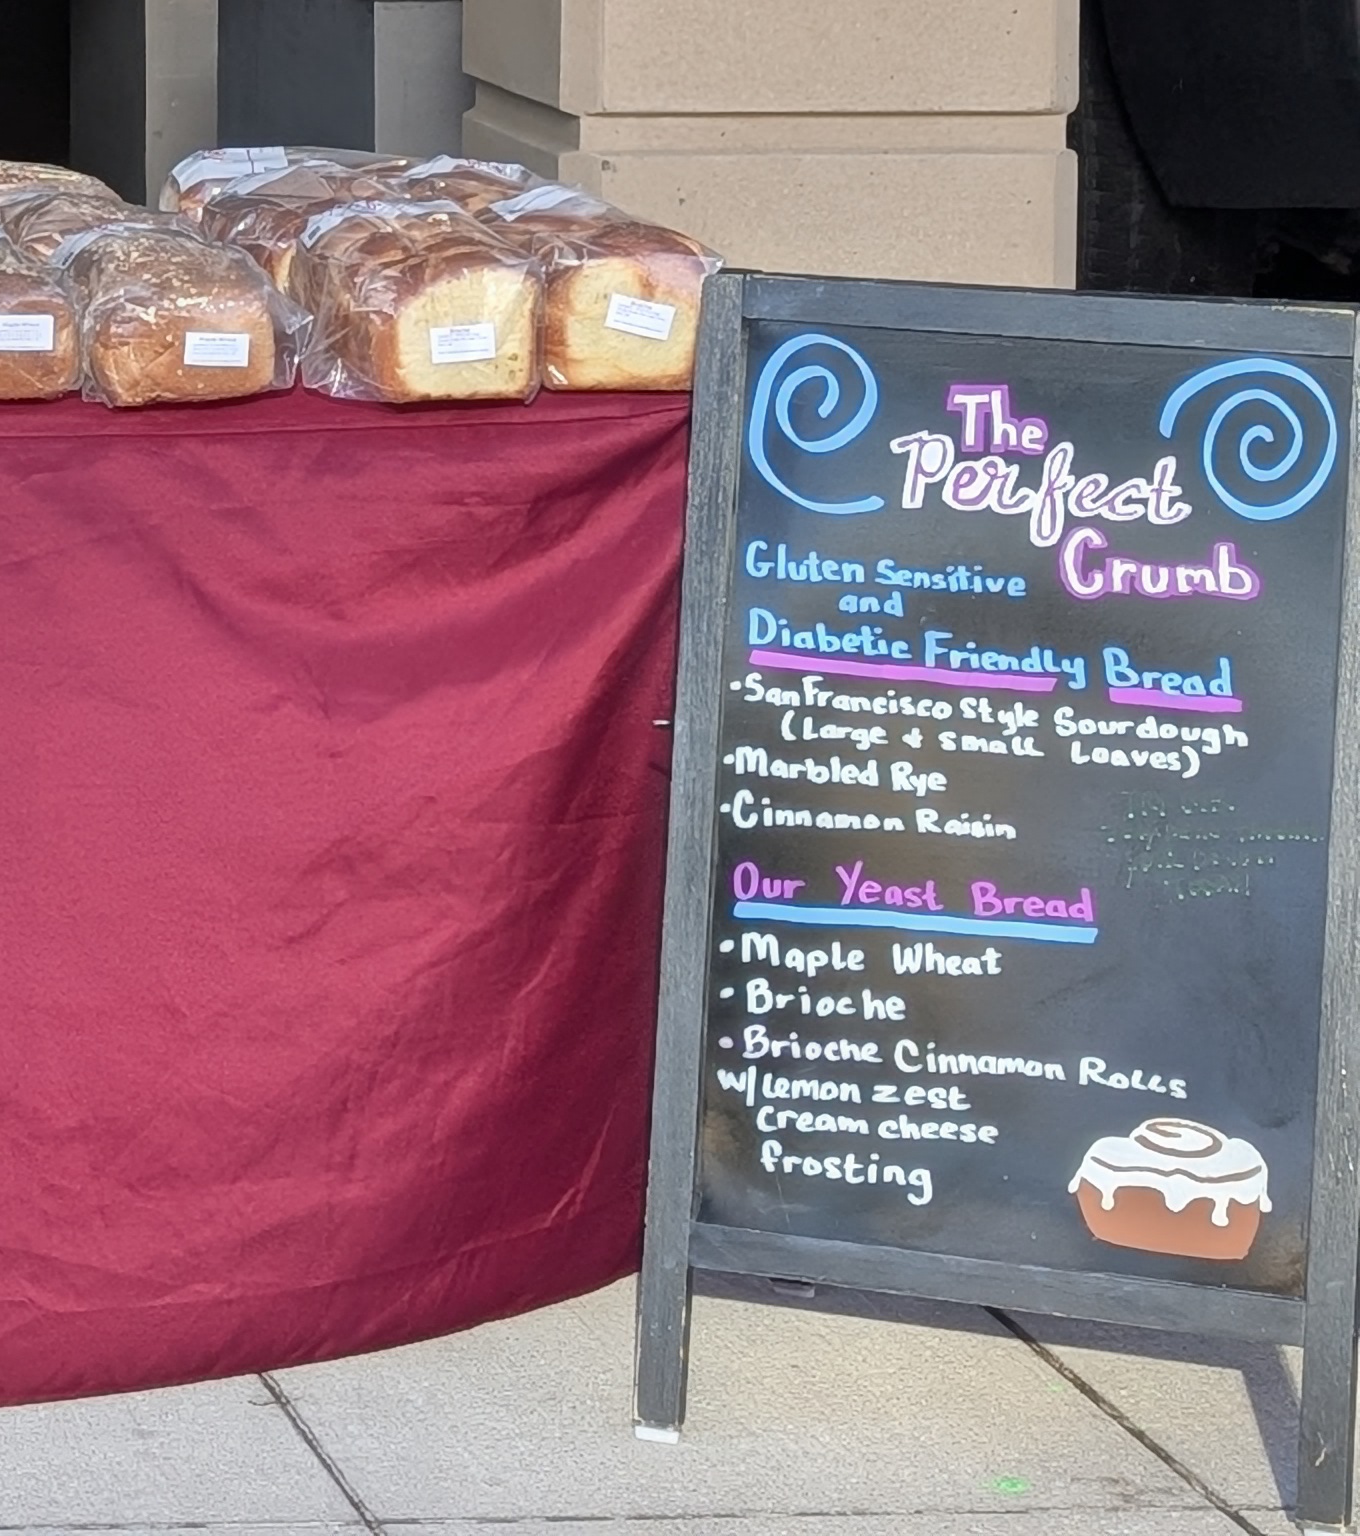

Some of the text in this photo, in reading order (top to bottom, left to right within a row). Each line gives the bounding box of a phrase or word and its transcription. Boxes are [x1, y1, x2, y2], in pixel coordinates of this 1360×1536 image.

[949, 386, 1047, 453] The
[890, 430, 1192, 547] Perfect
[745, 540, 1027, 597] Gluten Sensitive
[1060, 526, 1259, 599] Crumb
[838, 590, 904, 617] and
[748, 607, 1233, 697] Diabetic Friendly Bread
[781, 709, 889, 751] (Large
[1070, 740, 1201, 779] Loaves)
[959, 697, 1040, 736] Style
[1053, 706, 1249, 755] Sourdough
[735, 745, 948, 797] Marbled Rye
[732, 789, 1017, 840] Cinnamon Raisin
[734, 860, 1095, 923] Our Yeast Bread
[741, 931, 1003, 976] Maple Wheat
[745, 978, 907, 1022] Brioche
[742, 1024, 884, 1063] Brioche
[894, 1039, 1067, 1083] Cinnamon
[871, 1084, 972, 1111] zest
[877, 1114, 1000, 1144] cheese
[760, 1138, 933, 1206] frosting
